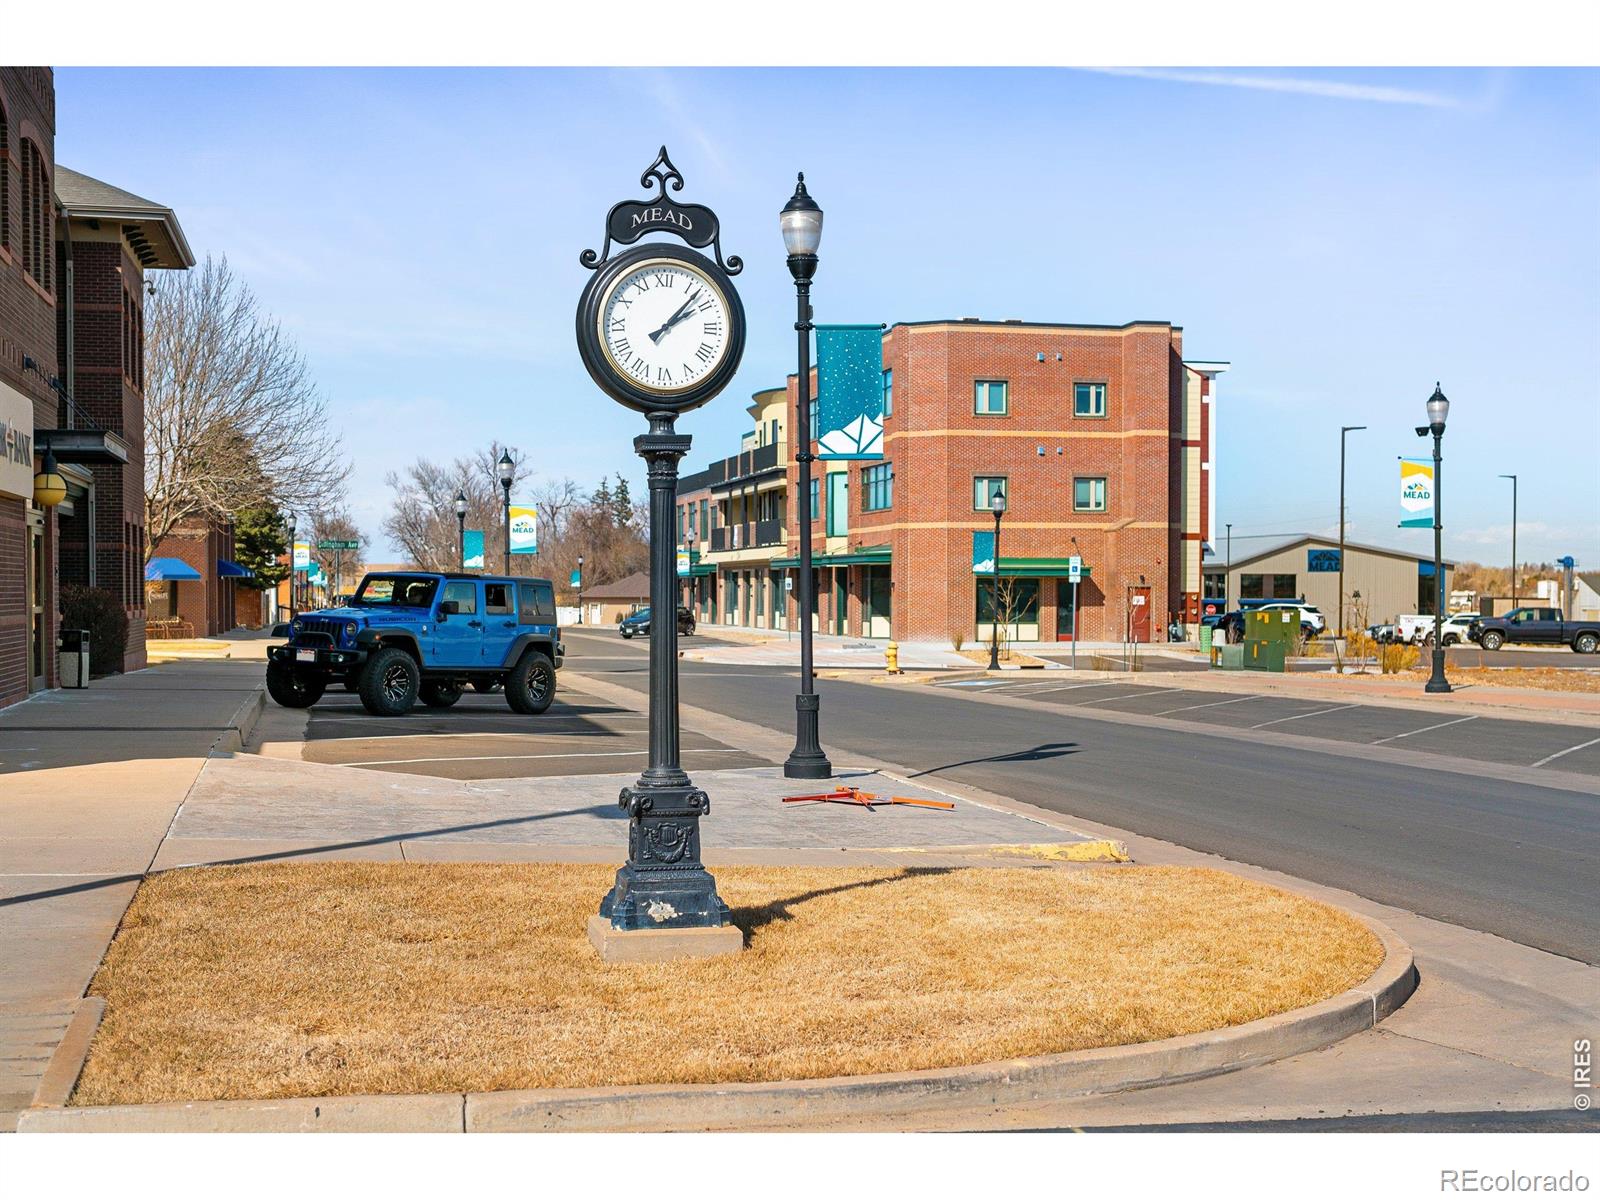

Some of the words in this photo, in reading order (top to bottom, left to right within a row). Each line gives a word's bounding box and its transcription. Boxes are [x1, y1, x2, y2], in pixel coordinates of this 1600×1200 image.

[631, 207, 693, 231] MEAD
[633, 277, 650, 295] XI
[655, 273, 674, 288] XII
[618, 295, 632, 309] X
[698, 300, 713, 312] II
[611, 317, 626, 332] IX
[703, 322, 717, 336] III
[658, 367, 672, 381] VI
[683, 363, 694, 377] V
[1403, 491, 1430, 499] MEAD
